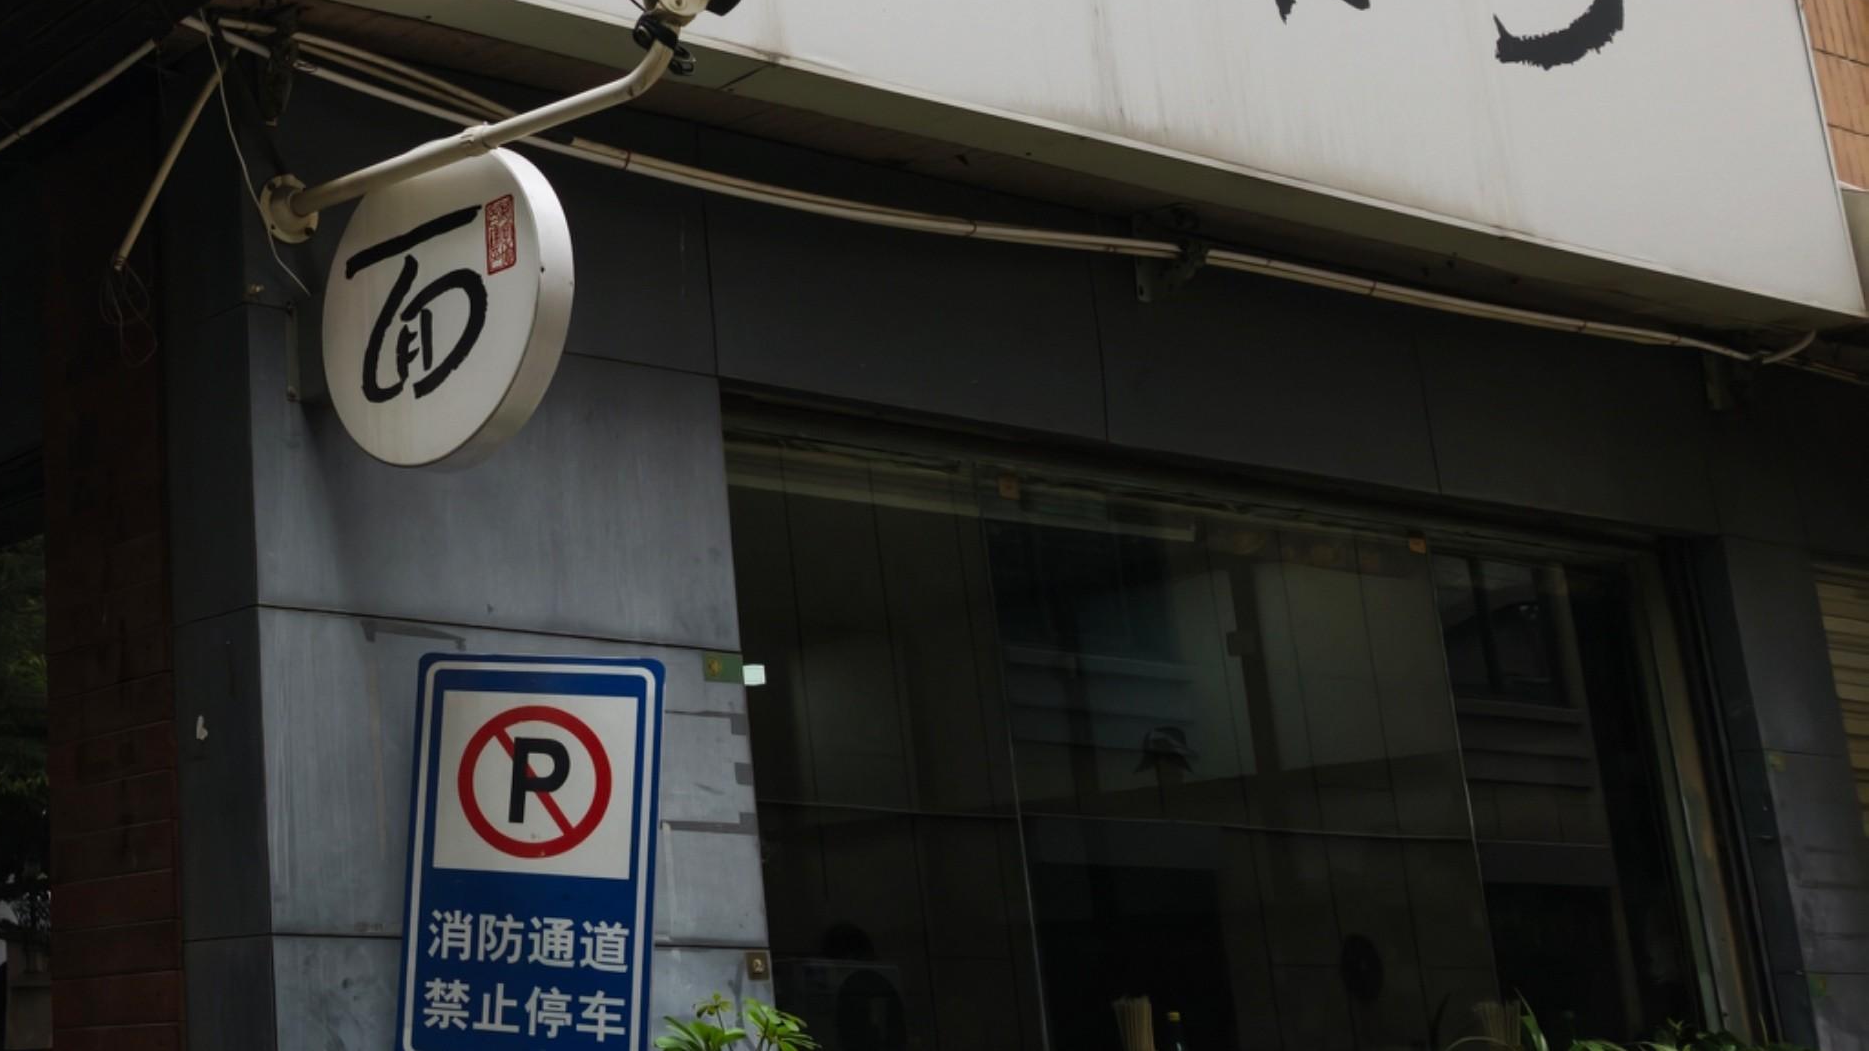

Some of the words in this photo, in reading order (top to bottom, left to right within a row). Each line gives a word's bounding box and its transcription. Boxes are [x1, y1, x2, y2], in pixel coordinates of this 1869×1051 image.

[344, 204, 489, 404] 面
[428, 909, 630, 974] 消防通道
[423, 977, 626, 1043] 禁止停车
